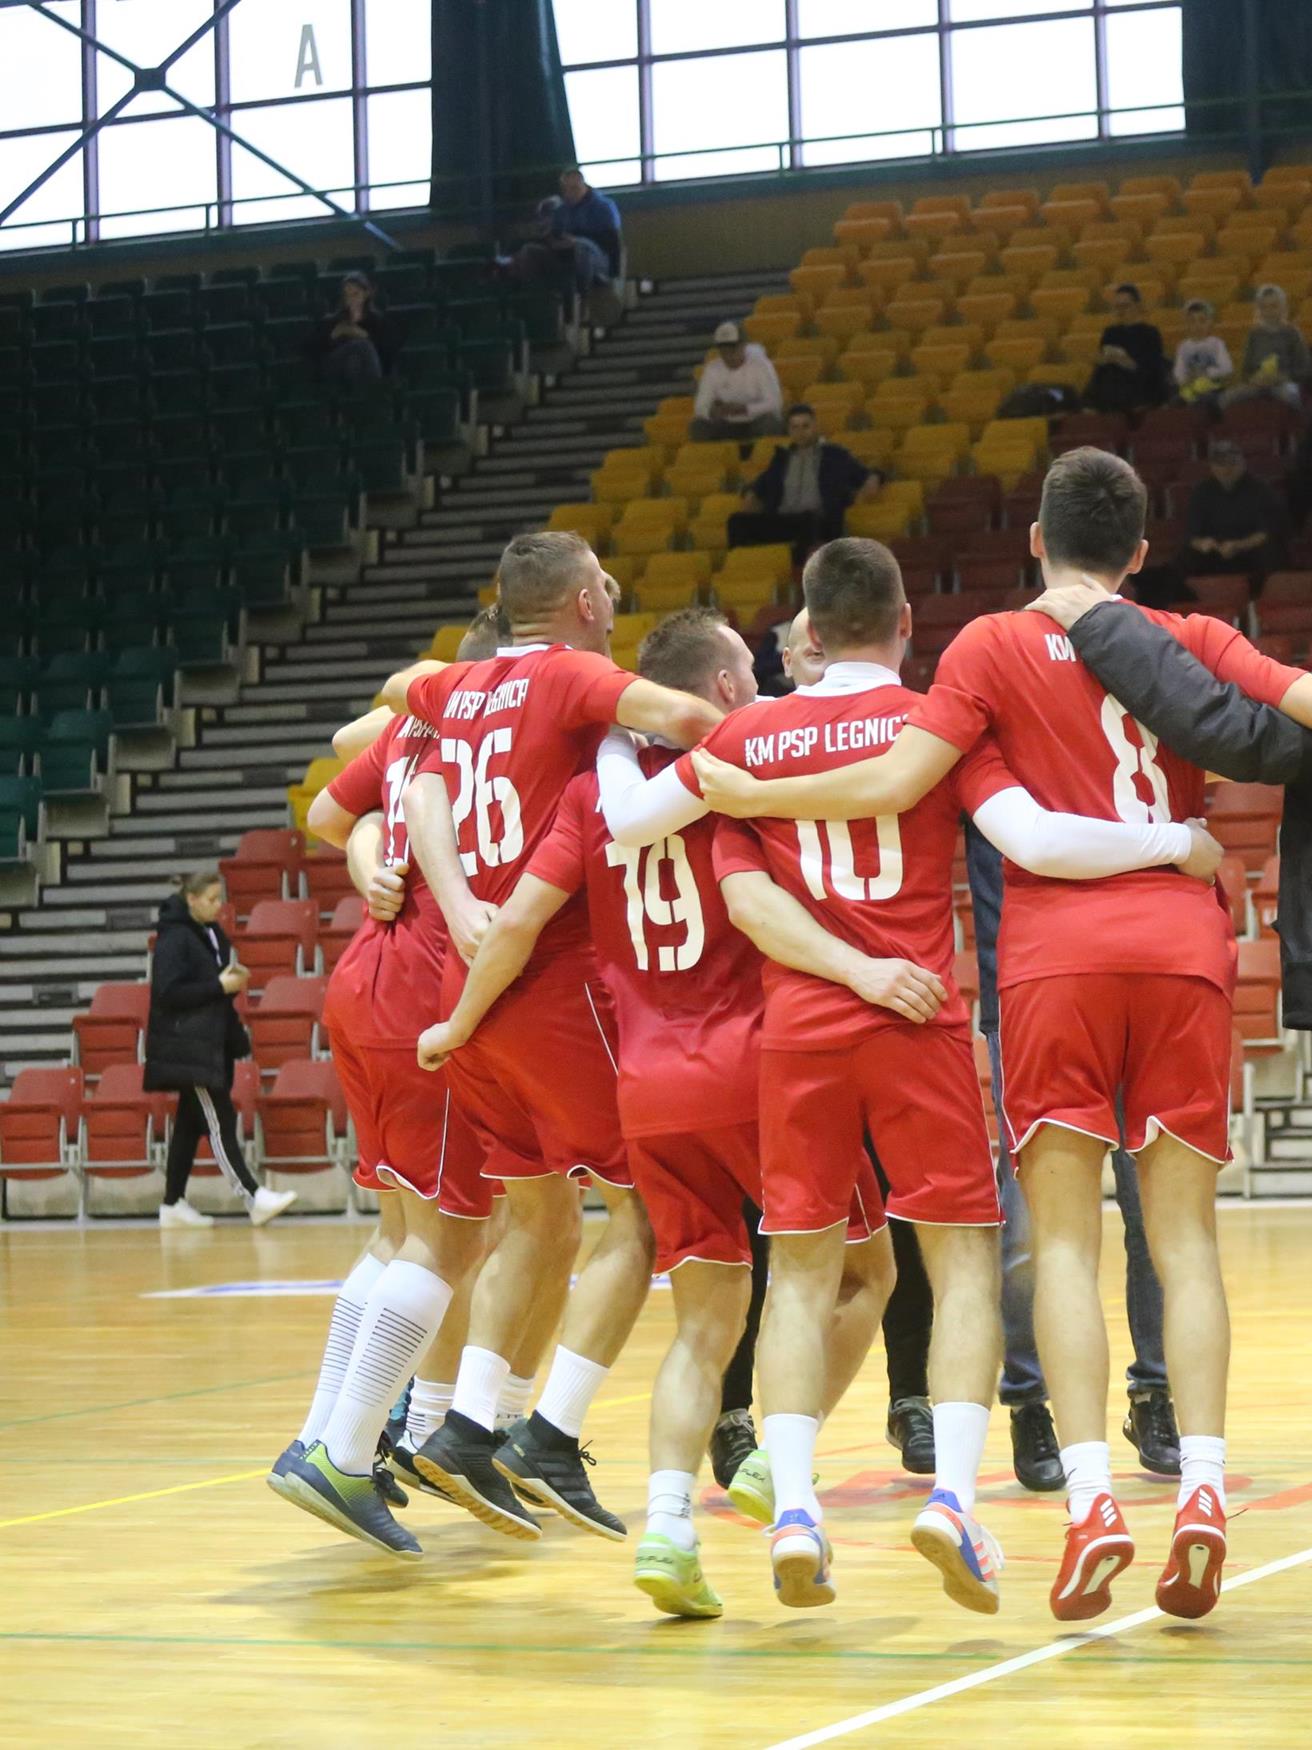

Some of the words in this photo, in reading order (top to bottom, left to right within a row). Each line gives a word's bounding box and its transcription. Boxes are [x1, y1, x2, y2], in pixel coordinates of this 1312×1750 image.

[295, 24, 323, 89] A
[440, 728, 524, 878] 26
[745, 735, 775, 768] KM
[778, 726, 819, 761] PSP
[824, 713, 909, 753] LEGNIC
[1101, 692, 1172, 824] 8
[605, 833, 705, 972] 19
